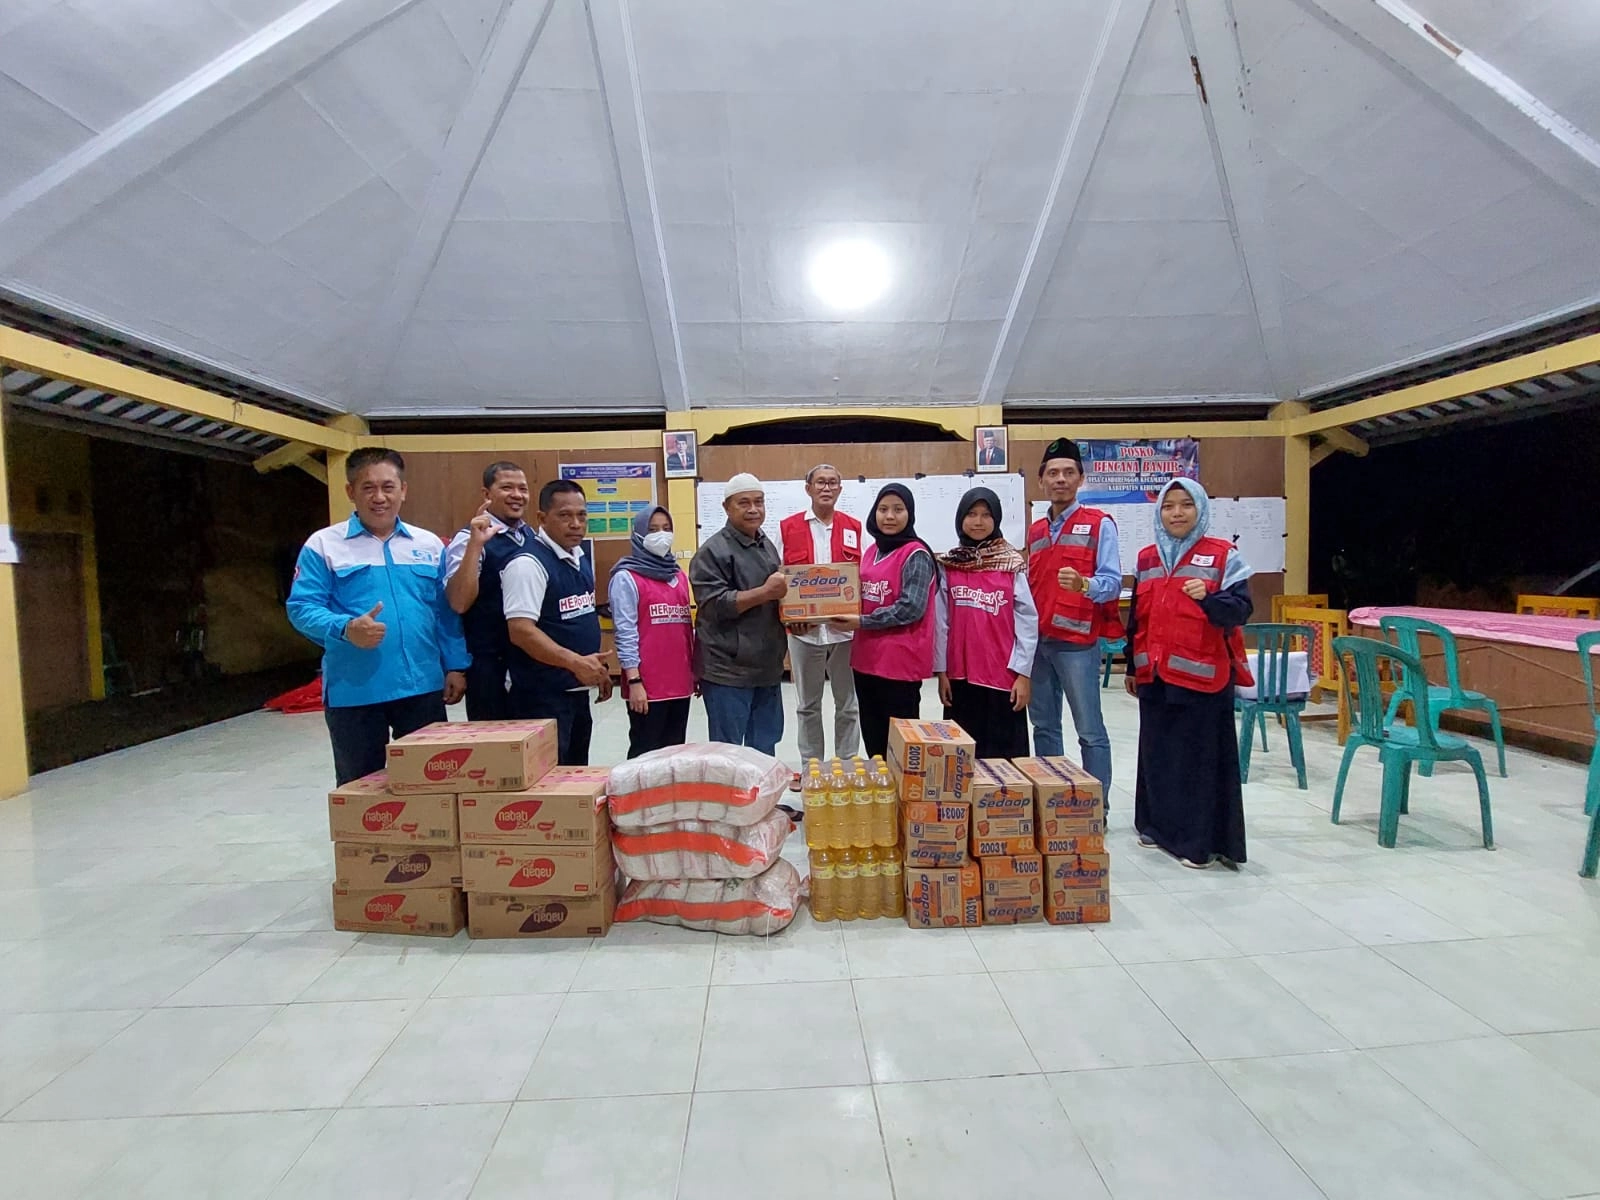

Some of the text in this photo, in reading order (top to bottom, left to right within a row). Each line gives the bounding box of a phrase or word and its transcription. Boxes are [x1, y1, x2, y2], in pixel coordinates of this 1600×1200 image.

[1120, 447, 1155, 457] POSKO
[1094, 461, 1180, 473] BENCANA BANJIR
[789, 576, 847, 588] Sedaap
[909, 745, 921, 770] 20031
[427, 759, 458, 771] nabati
[953, 747, 965, 799] Sedaap
[909, 783, 921, 799] 40
[977, 798, 1031, 809] Sedaap
[365, 811, 393, 823] nabati
[499, 810, 528, 821] nabati
[941, 807, 966, 819] 20031
[398, 863, 428, 874] nabati
[522, 867, 552, 878] nabati
[1054, 867, 1109, 879] Sedaap
[963, 871, 974, 887] 40
[920, 874, 931, 926] Sedaap
[367, 903, 394, 913] nabati
[966, 898, 977, 924] 20031
[988, 905, 1040, 917] Sedaap
[533, 911, 564, 923] nabati
